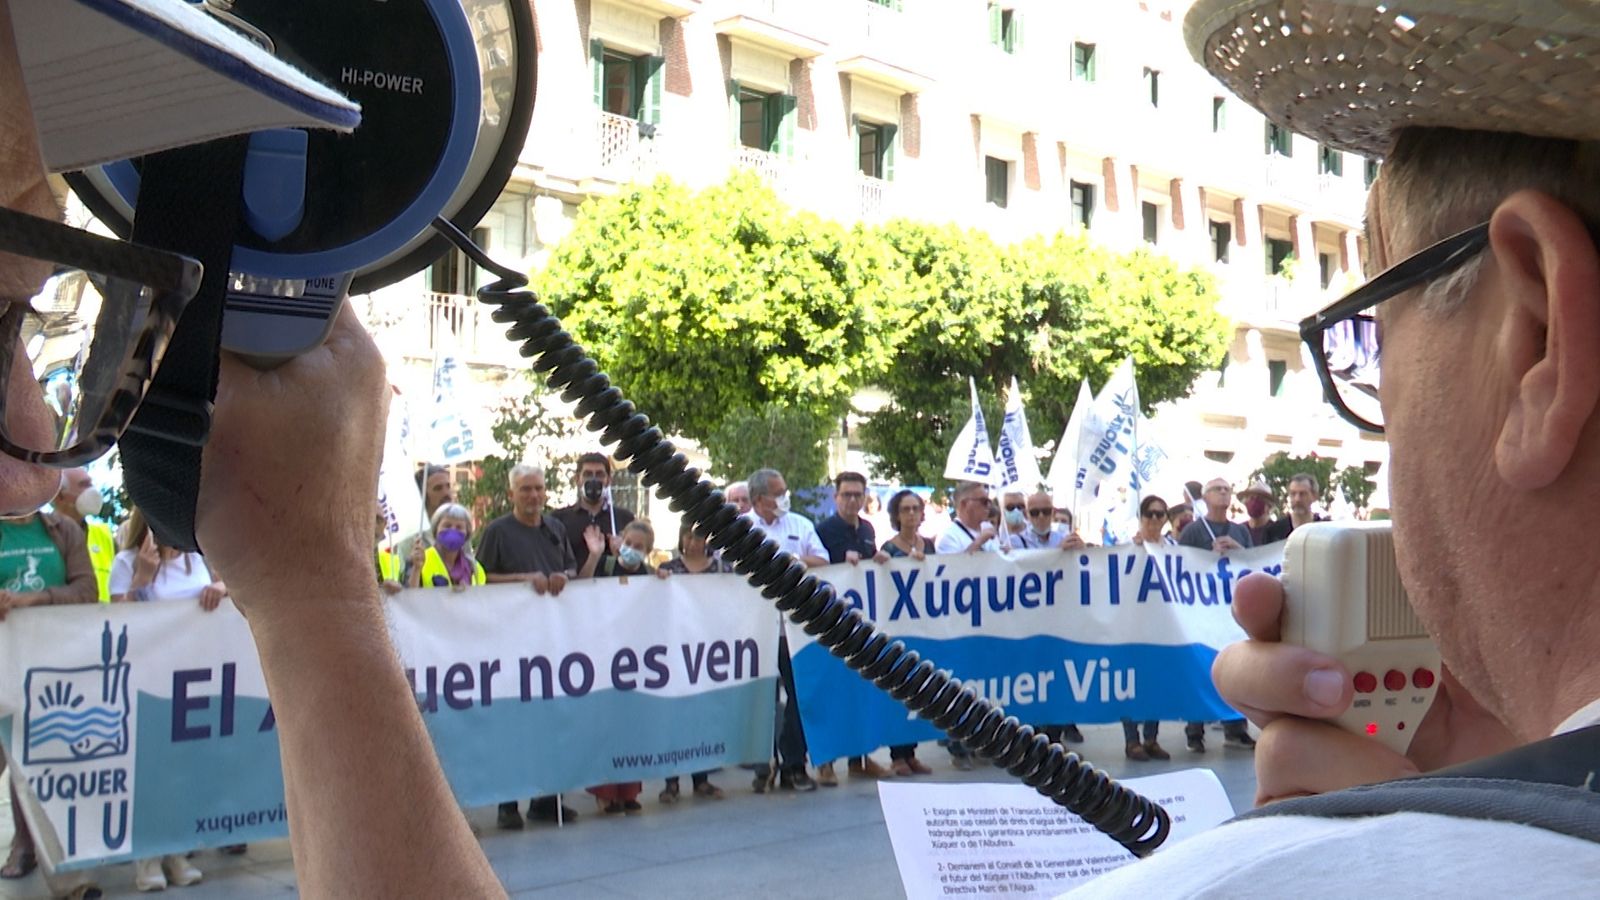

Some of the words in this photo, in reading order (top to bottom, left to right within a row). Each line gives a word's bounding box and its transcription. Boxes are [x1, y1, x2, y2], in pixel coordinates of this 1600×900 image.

[341, 67, 424, 95] HI-POWER
[888, 565, 1063, 627] Xúquer
[1080, 555, 1091, 606] i
[171, 662, 236, 743] El
[519, 650, 595, 701] no
[611, 644, 670, 691] es
[681, 636, 760, 686] ven
[1063, 657, 1136, 703] Viu
[611, 742, 726, 768] www.xuquerviu.es
[947, 861, 986, 871] Demanem
[942, 885, 977, 895] Directiva
